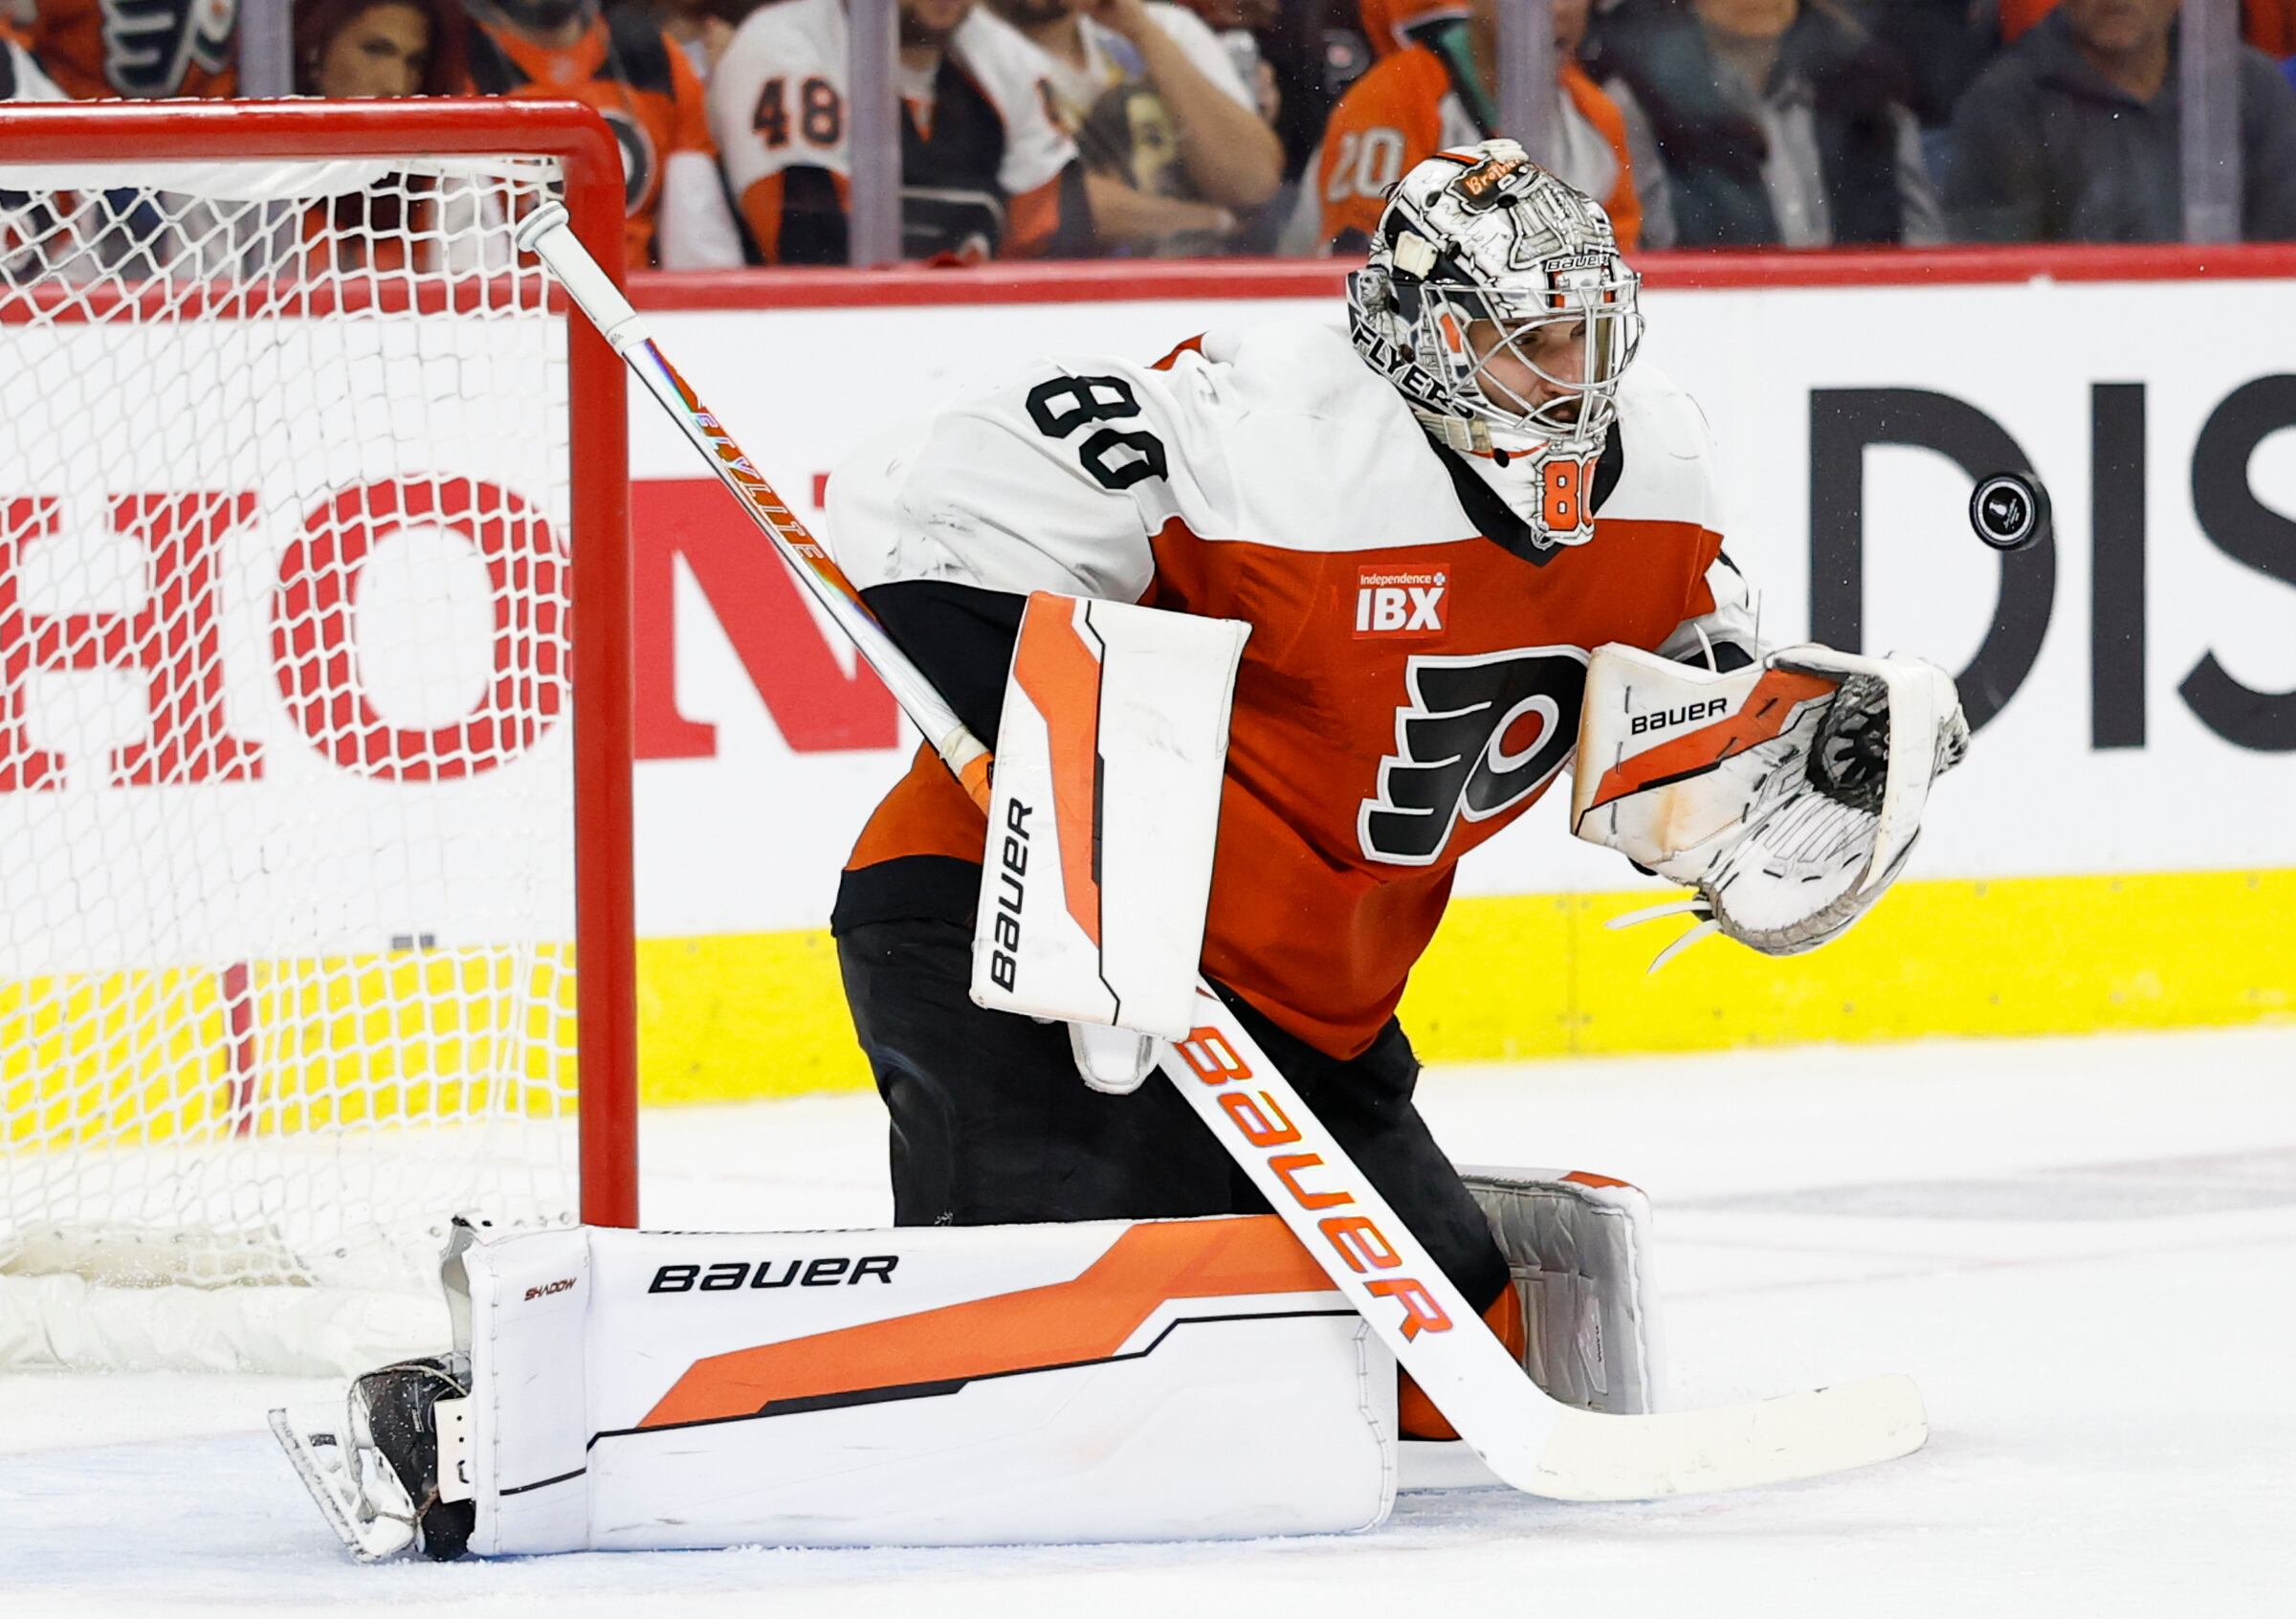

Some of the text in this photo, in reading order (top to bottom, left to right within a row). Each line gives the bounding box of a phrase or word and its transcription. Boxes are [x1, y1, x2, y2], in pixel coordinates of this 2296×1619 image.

[753, 76, 840, 149] 48
[1545, 254, 1610, 273] BAUER
[1026, 375, 1168, 490] 80
[1360, 572, 1432, 587] Independence
[1808, 372, 2296, 755] DIS
[1356, 587, 1446, 632] IBX
[1631, 698, 1728, 736] BAUER
[991, 797, 1033, 994] BAUER
[1173, 1026, 1453, 1343] BAUER
[523, 1277, 578, 1302] SHADOW
[648, 1255, 899, 1294] BAUER
